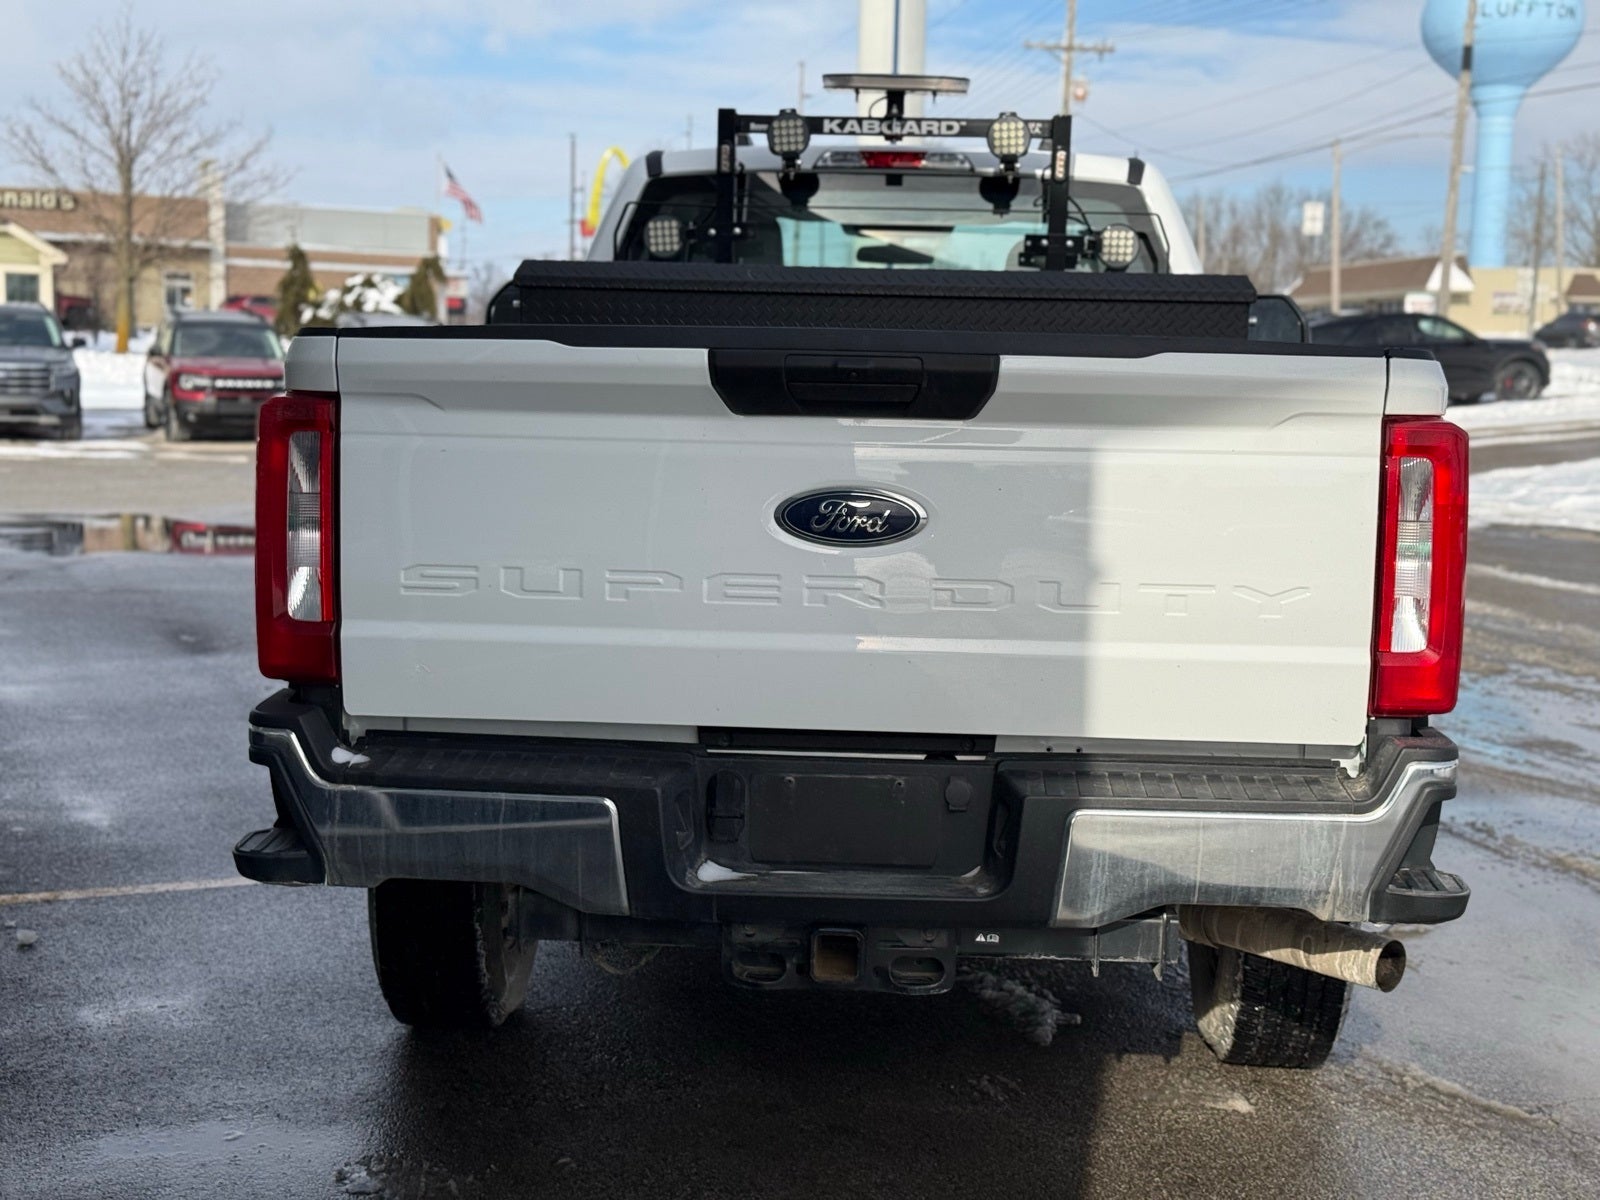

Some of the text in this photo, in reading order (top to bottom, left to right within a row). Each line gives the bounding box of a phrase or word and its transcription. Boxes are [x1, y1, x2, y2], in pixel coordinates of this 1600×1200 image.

[1480, 0, 1577, 19] LUFFTON
[0, 190, 76, 211] nald's
[810, 499, 891, 533] Ford
[400, 564, 1312, 619] SUPER DUTY
